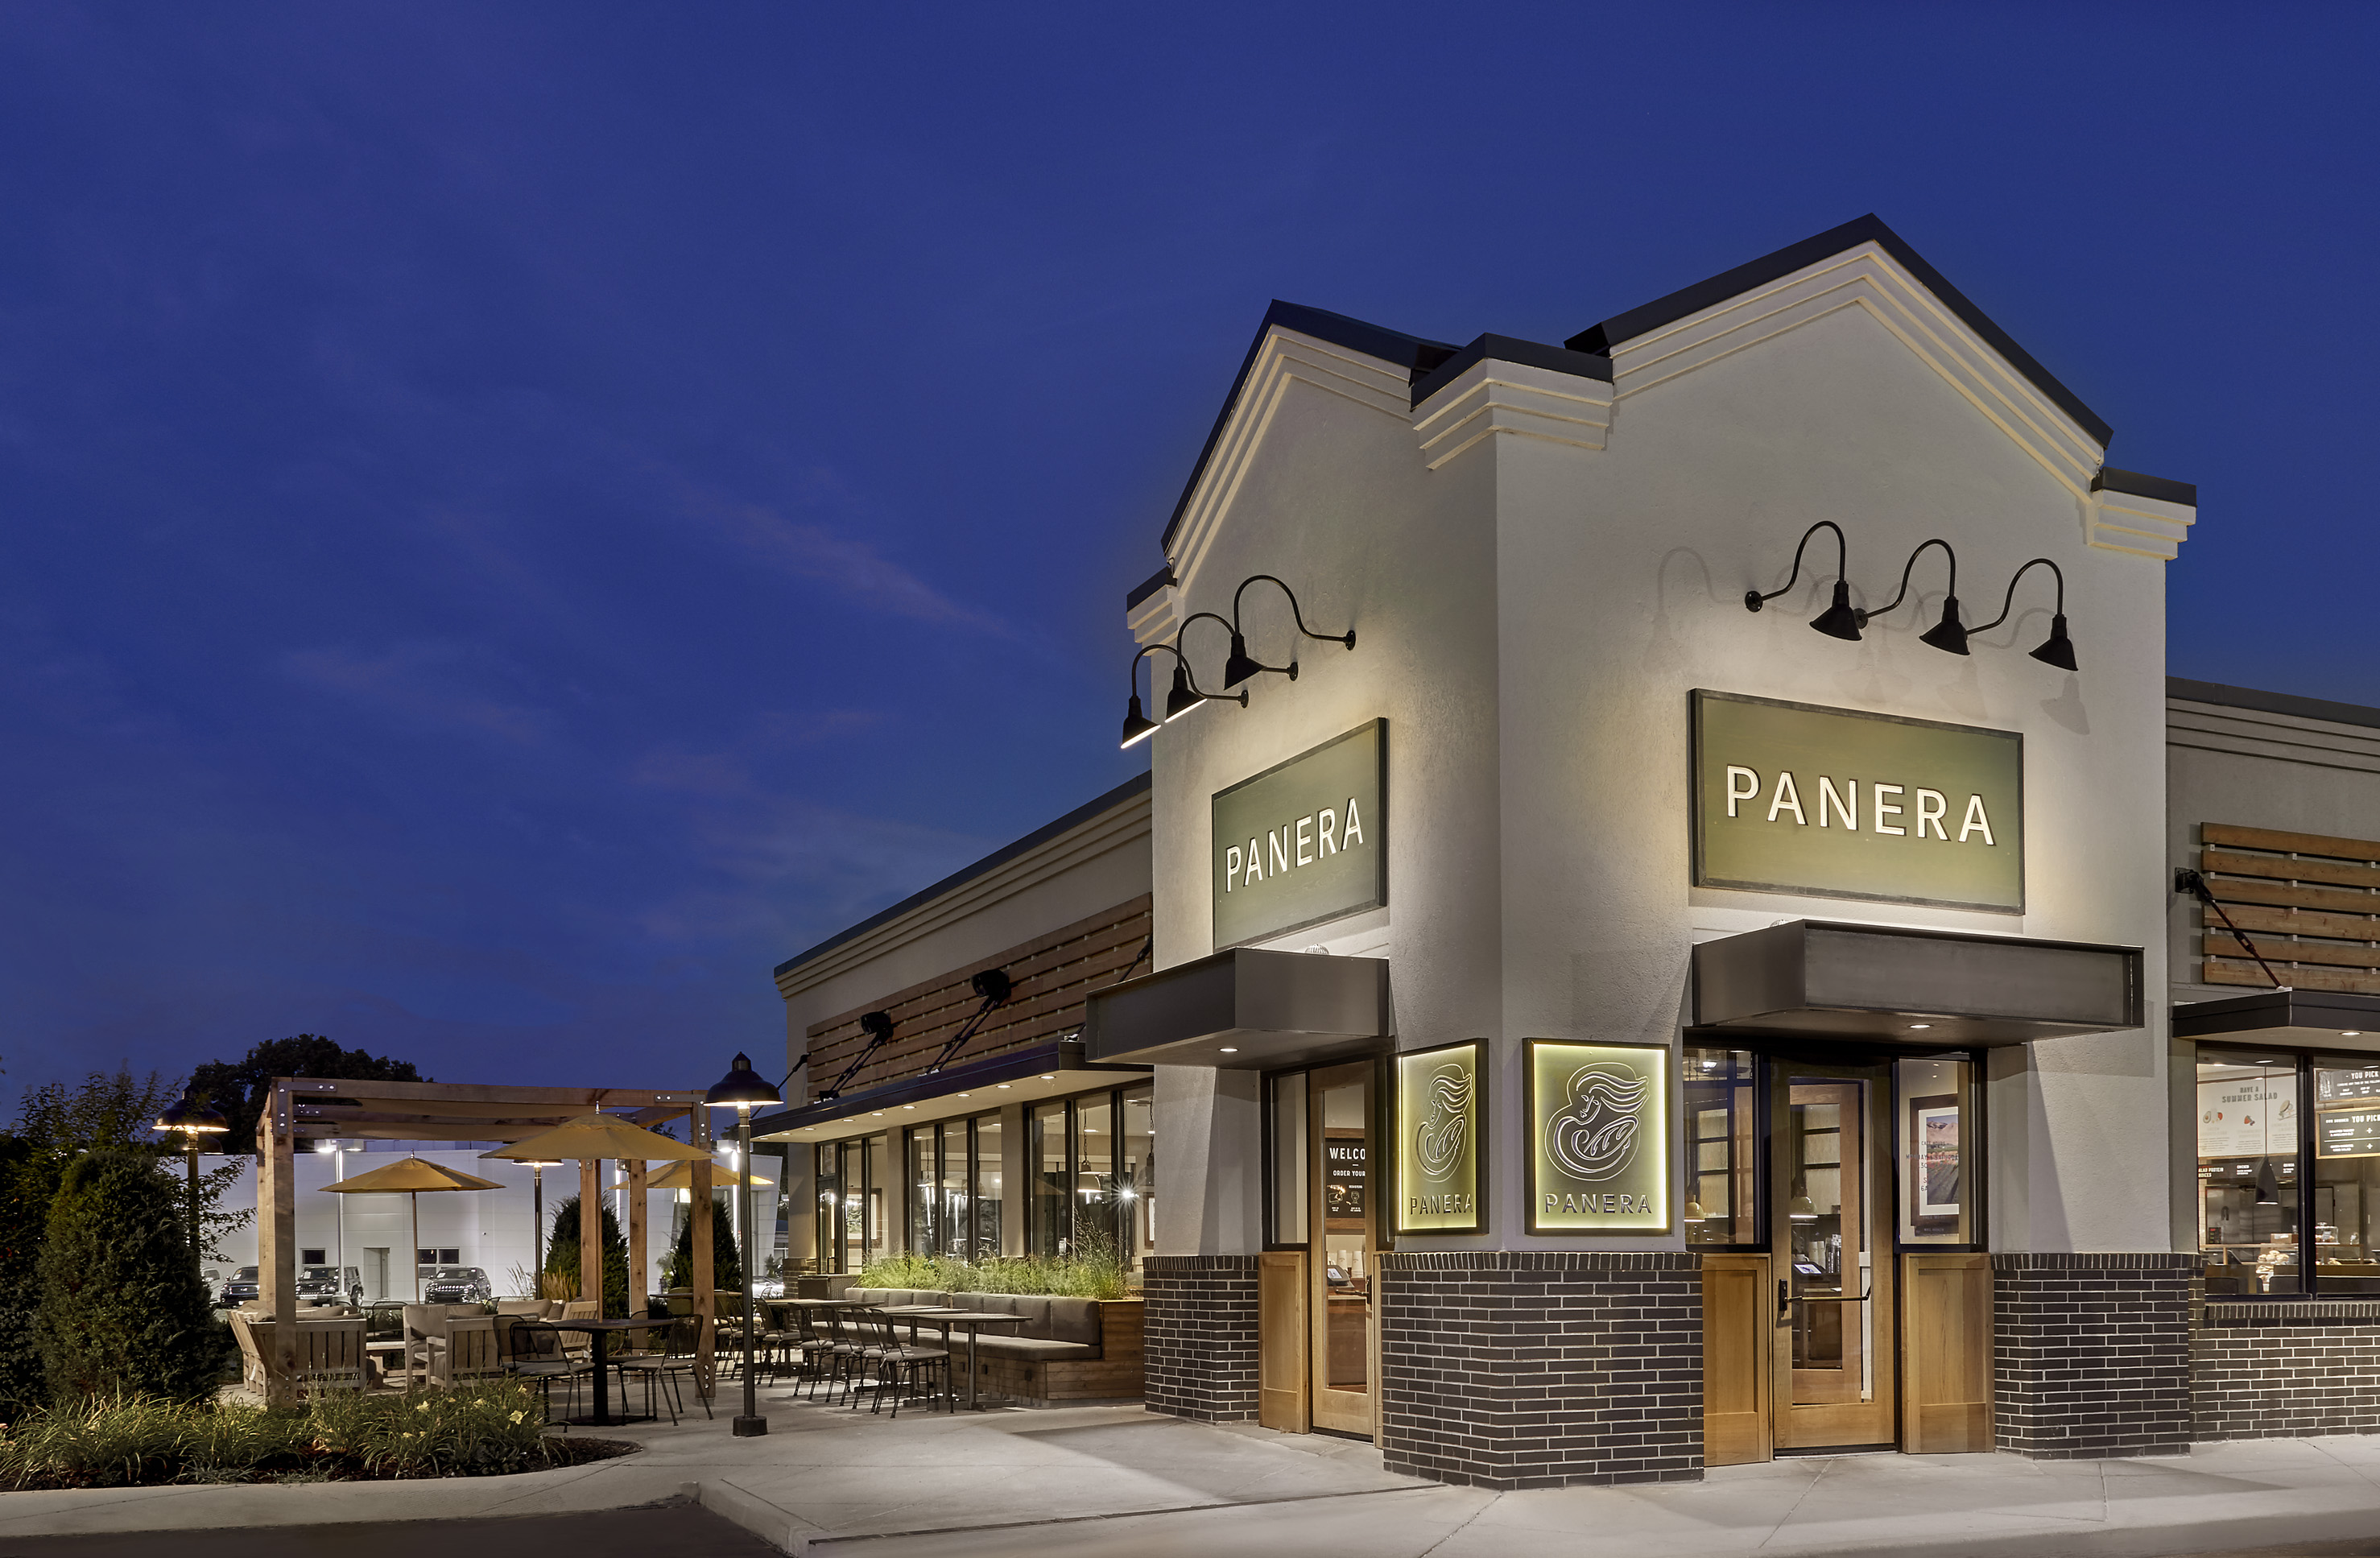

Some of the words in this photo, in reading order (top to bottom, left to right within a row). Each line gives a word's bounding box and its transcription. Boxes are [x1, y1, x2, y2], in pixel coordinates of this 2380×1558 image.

[1727, 764, 1997, 846] PANERA
[1225, 797, 1364, 893] PANERA
[2351, 1072, 2363, 1080] YOU
[2222, 1094, 2252, 1103] SUMMER
[2254, 1092, 2278, 1101] SALAD
[2352, 1115, 2365, 1123] YOU
[1329, 1147, 1366, 1160] WELCO
[1410, 1193, 1473, 1215] PANERA
[1545, 1193, 1652, 1214] PANERA
